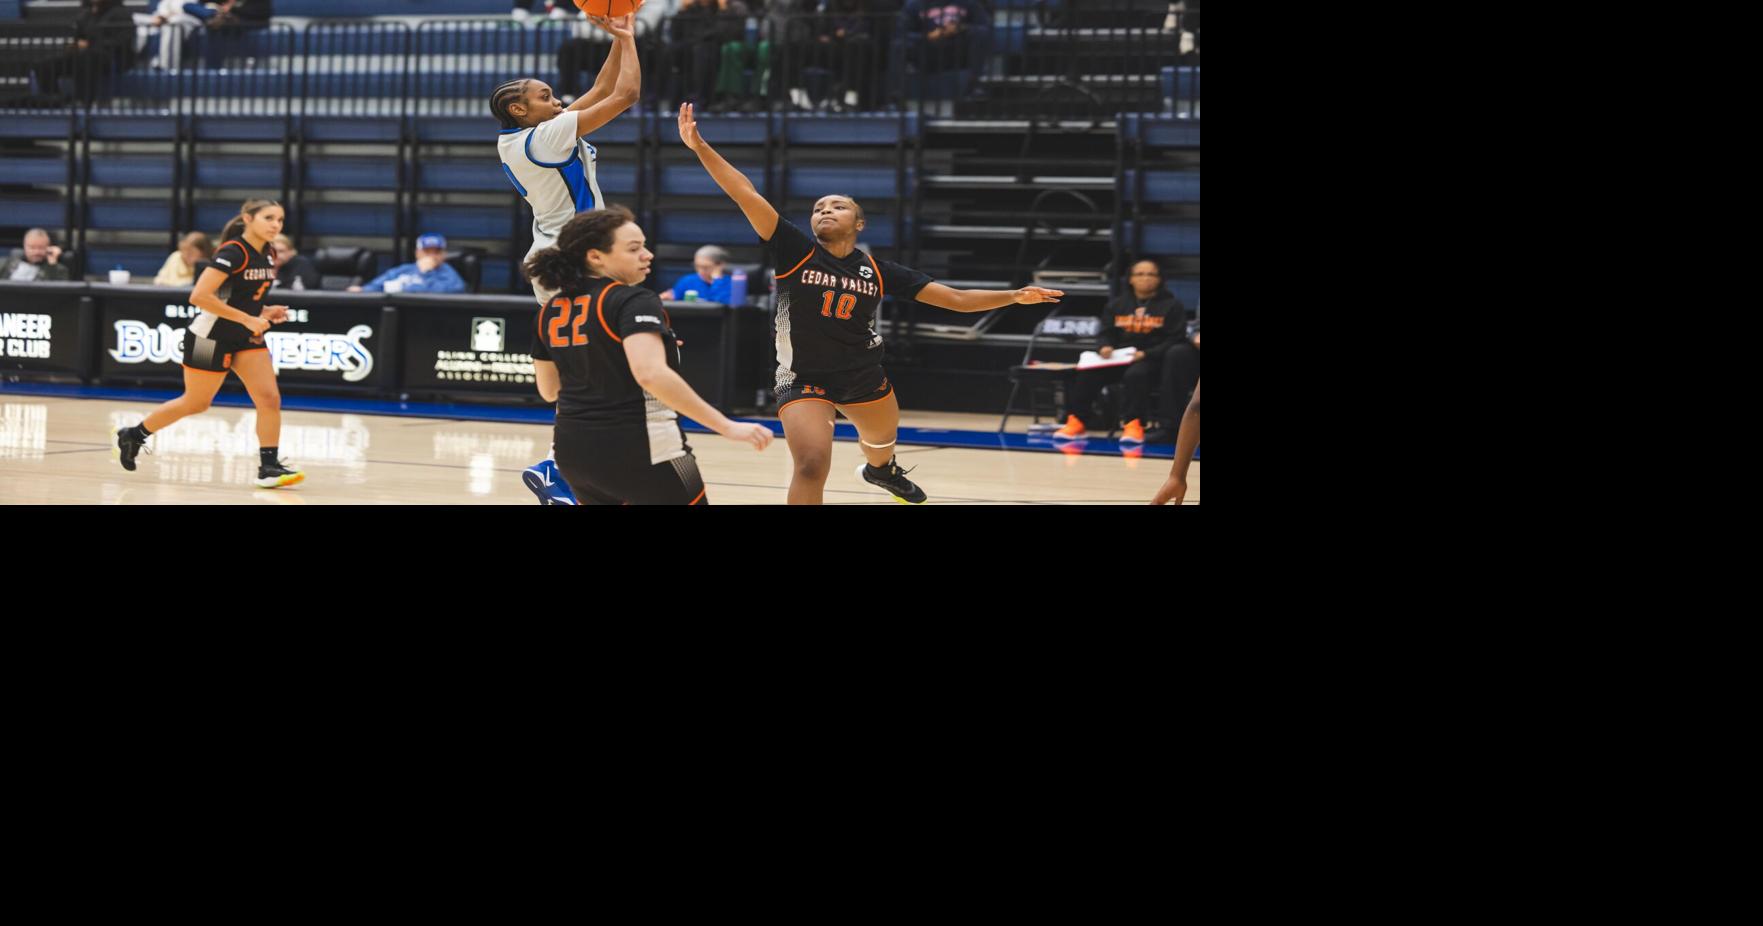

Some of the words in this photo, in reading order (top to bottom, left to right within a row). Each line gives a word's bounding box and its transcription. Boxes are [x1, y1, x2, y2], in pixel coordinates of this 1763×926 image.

[801, 269, 837, 287] CEDAR
[841, 277, 879, 297] VALLEY
[821, 290, 857, 320] 10
[548, 295, 592, 347] 22
[7, 338, 51, 359] CLUB
